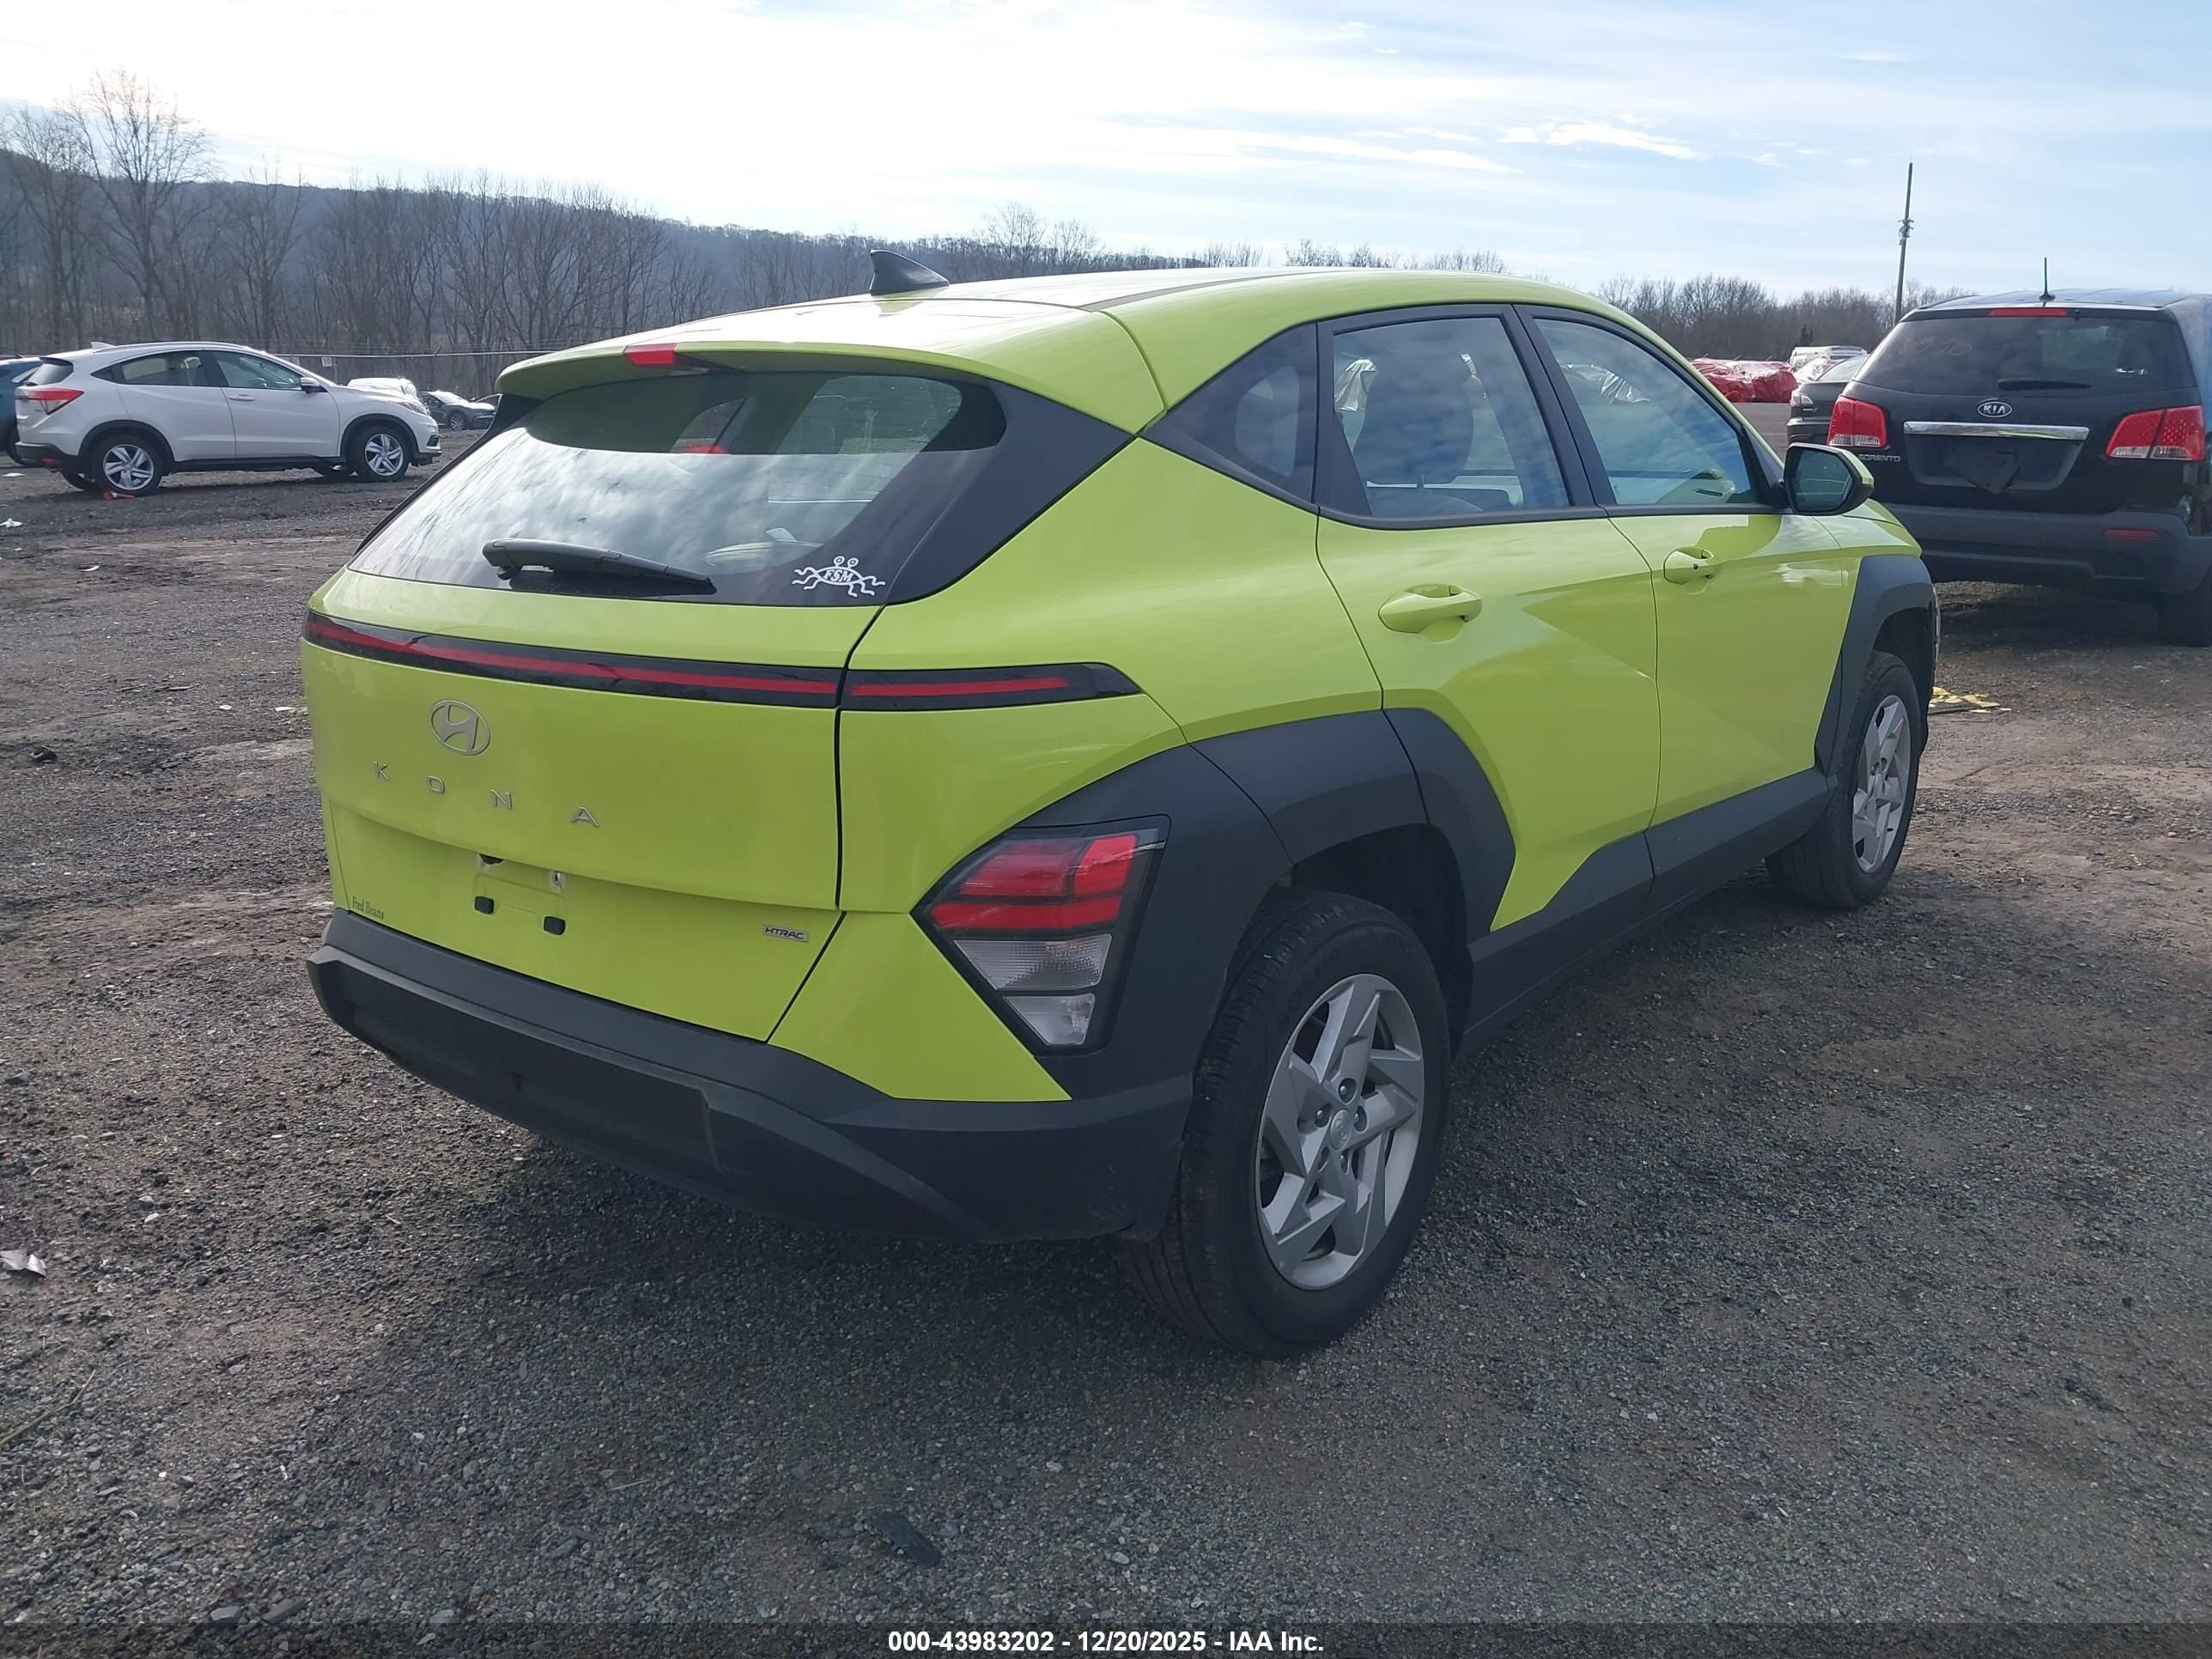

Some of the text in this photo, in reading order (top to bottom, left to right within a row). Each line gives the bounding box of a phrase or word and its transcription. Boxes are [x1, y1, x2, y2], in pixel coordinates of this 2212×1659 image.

[1984, 404, 2006, 414] KIA
[823, 568, 854, 583] FSM
[372, 761, 599, 827] KONA
[764, 927, 805, 940] HTRAC
